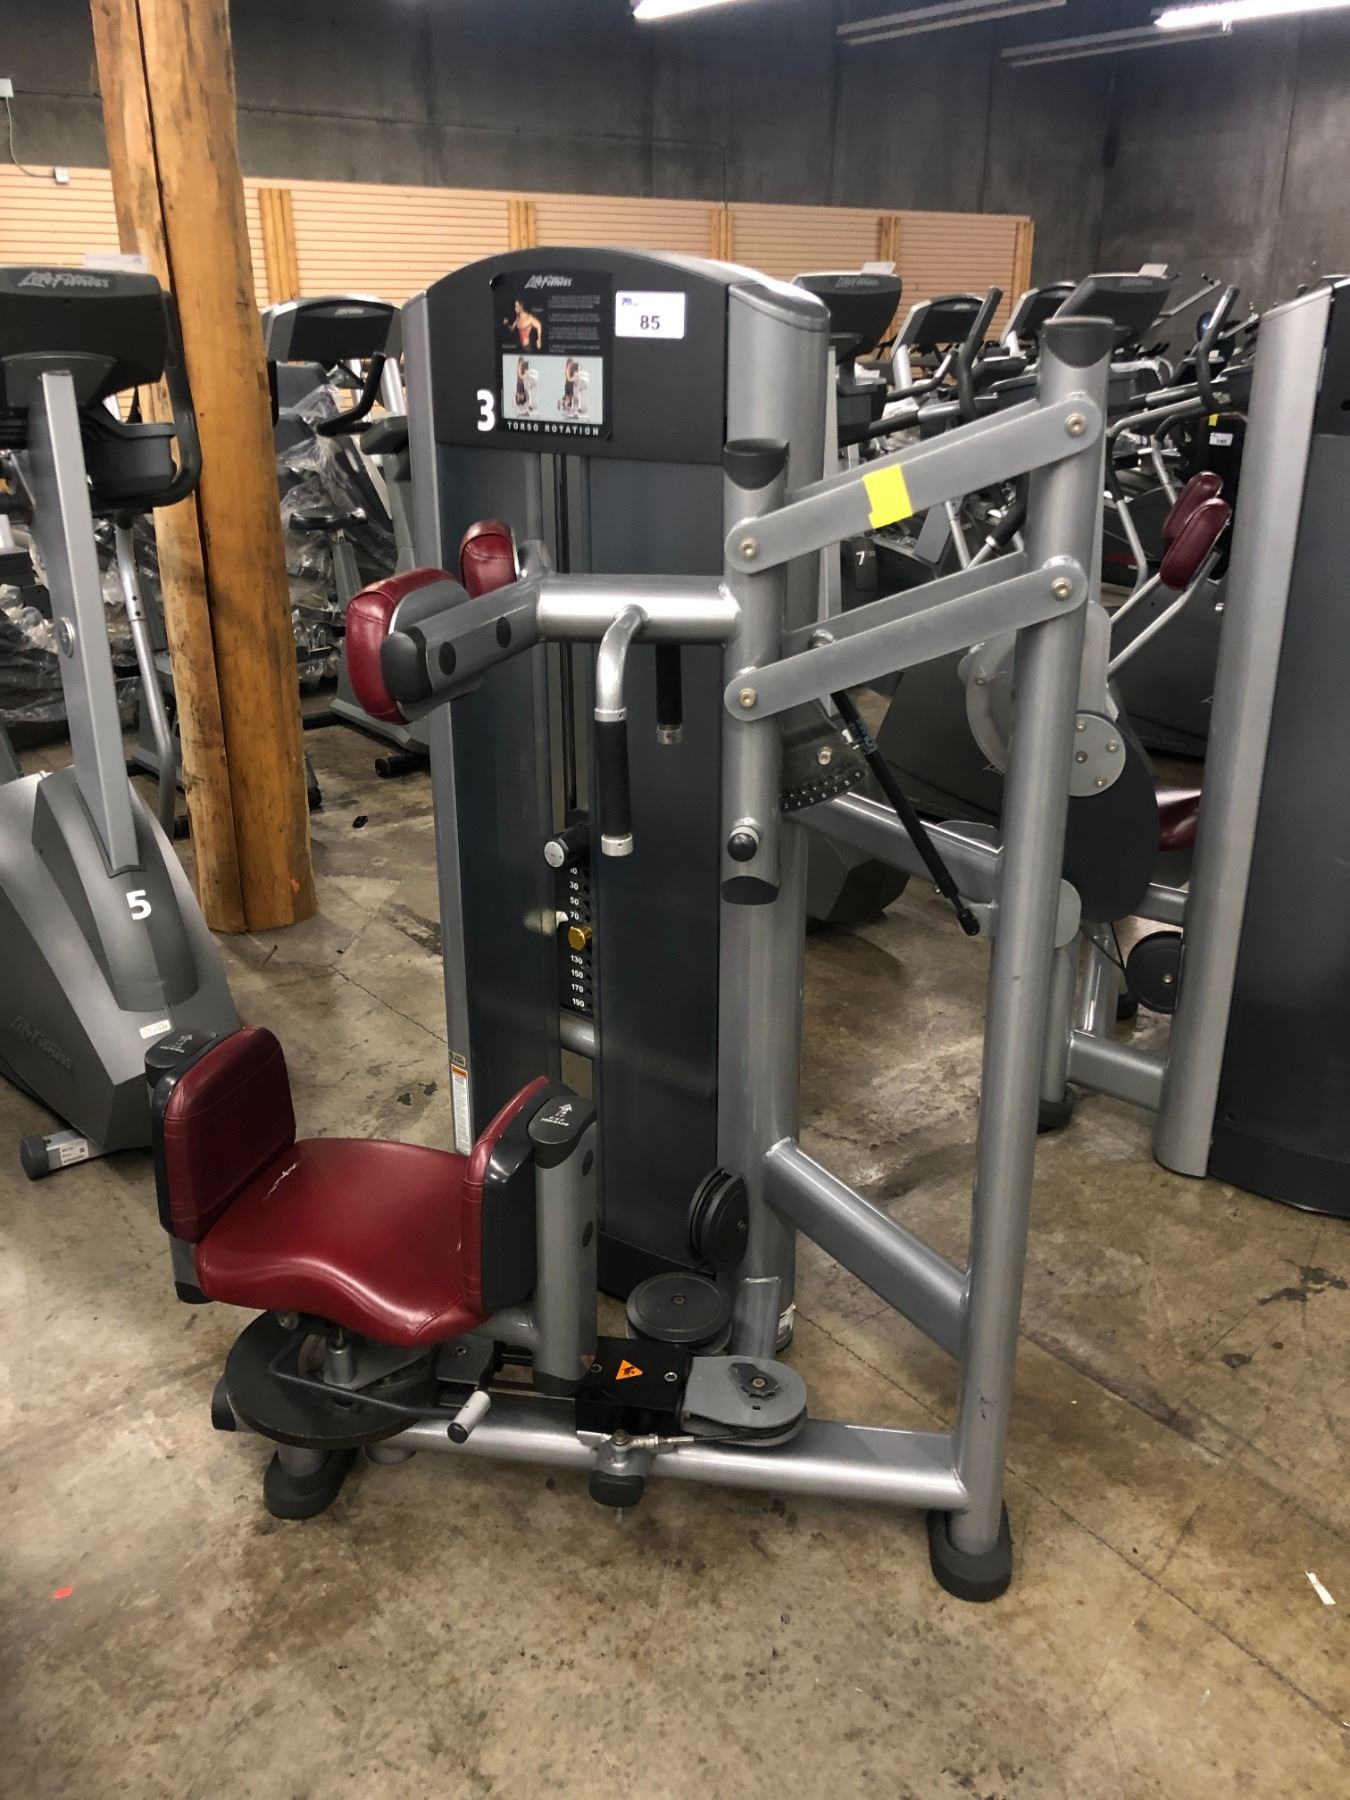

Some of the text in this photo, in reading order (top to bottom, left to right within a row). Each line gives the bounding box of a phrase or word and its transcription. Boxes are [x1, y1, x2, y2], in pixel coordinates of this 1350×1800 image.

[640, 315, 660, 330] 85
[476, 389, 495, 432] 3
[507, 421, 600, 436] TORSO ROTATION
[855, 551, 865, 566] 7
[569, 881, 579, 891] 30
[125, 889, 152, 921] 5
[569, 896, 580, 906] 50
[569, 911, 580, 921] 70
[570, 954, 583, 965] 130
[570, 968, 584, 979] 150
[571, 983, 584, 993] 170
[572, 997, 585, 1008] 190
